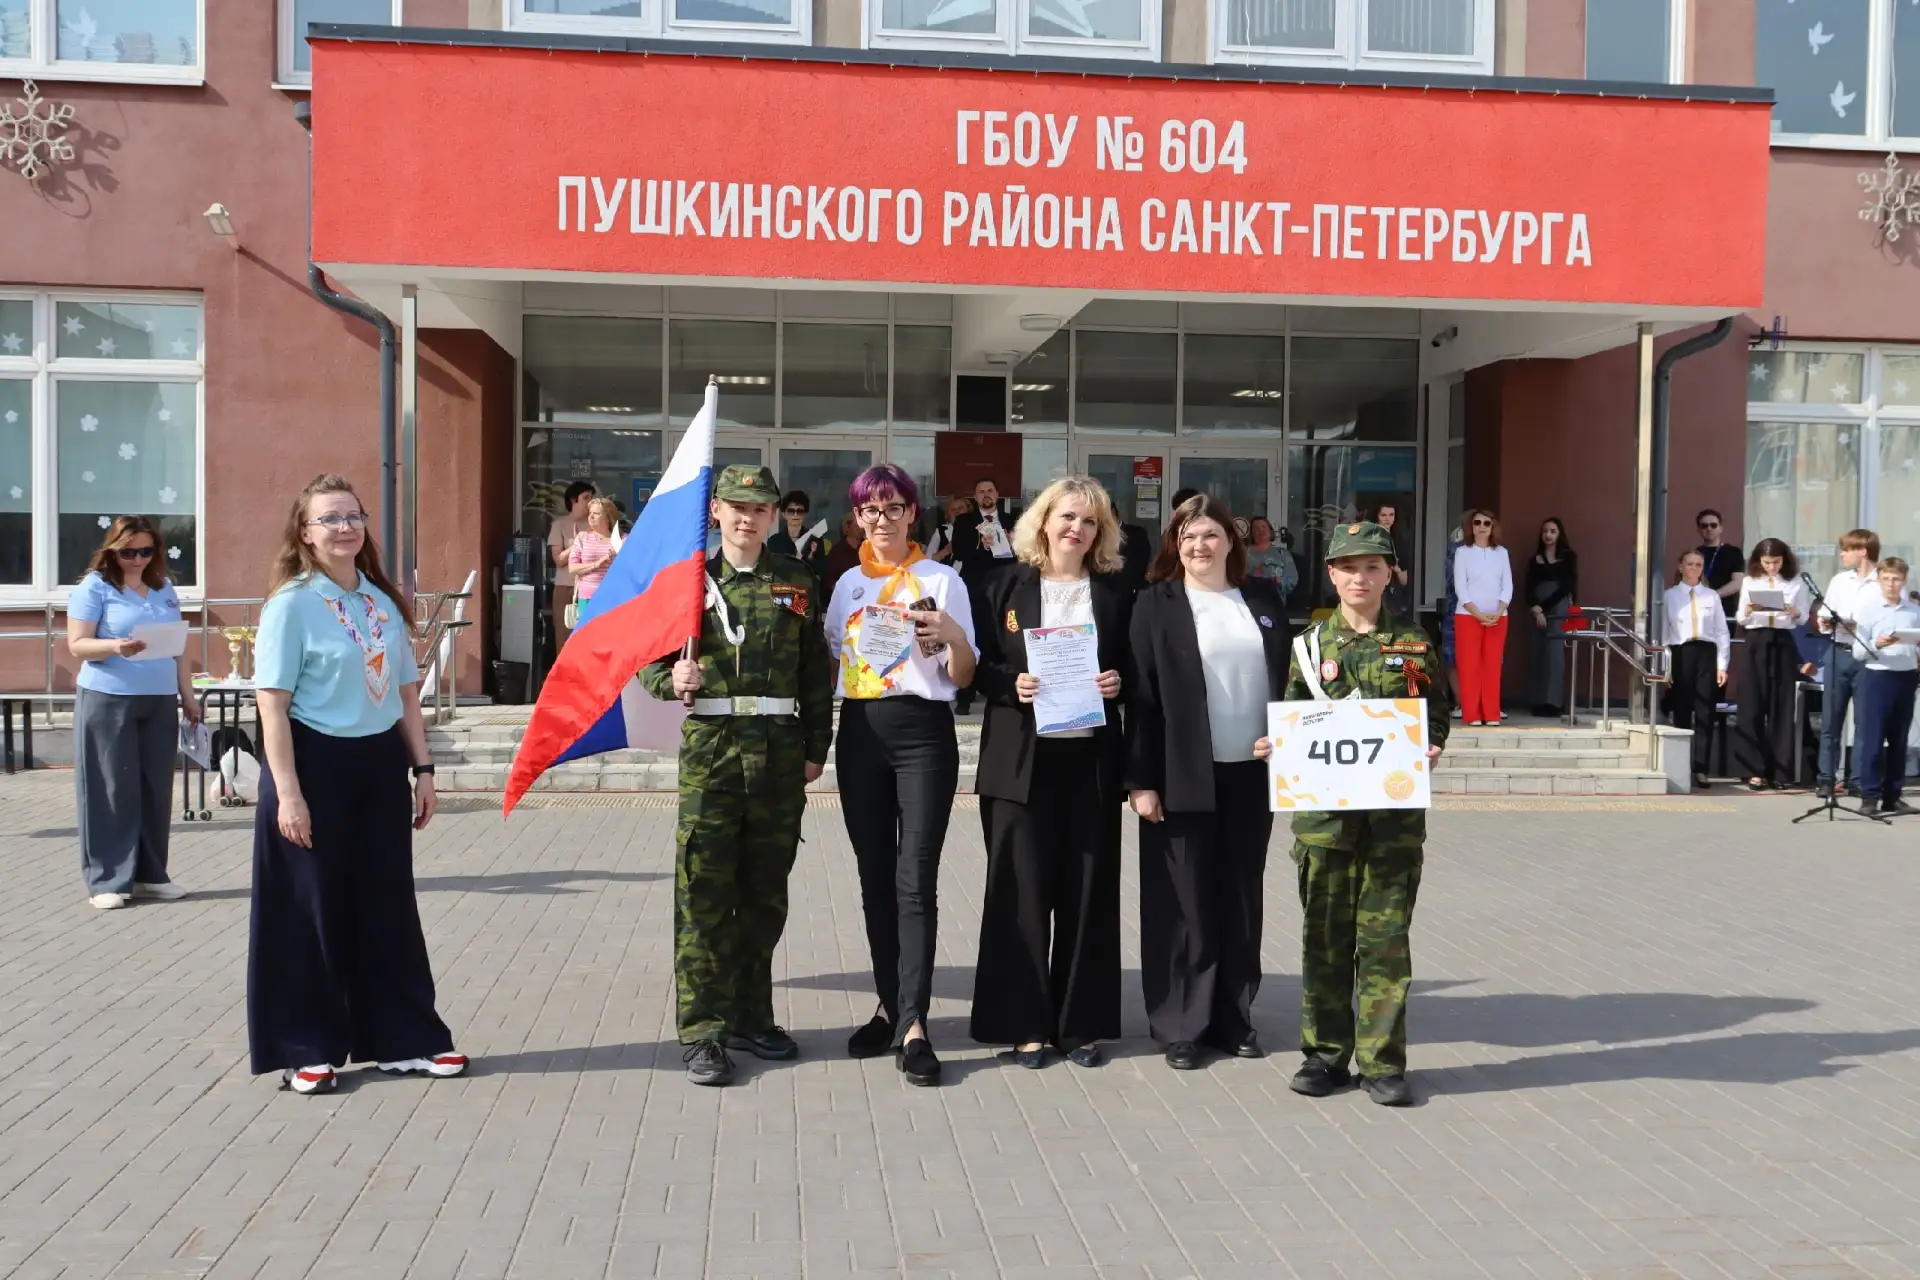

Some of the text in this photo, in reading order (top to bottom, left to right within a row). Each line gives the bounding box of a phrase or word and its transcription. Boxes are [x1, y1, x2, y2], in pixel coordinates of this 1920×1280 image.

[956, 110, 1248, 175] ГБОУ № 604
[558, 175, 1592, 267] ПУШКИНСКОГО РАЙОНА САНКТ-ПЕТЕРБУРГА
[1307, 738, 1385, 765] 407
